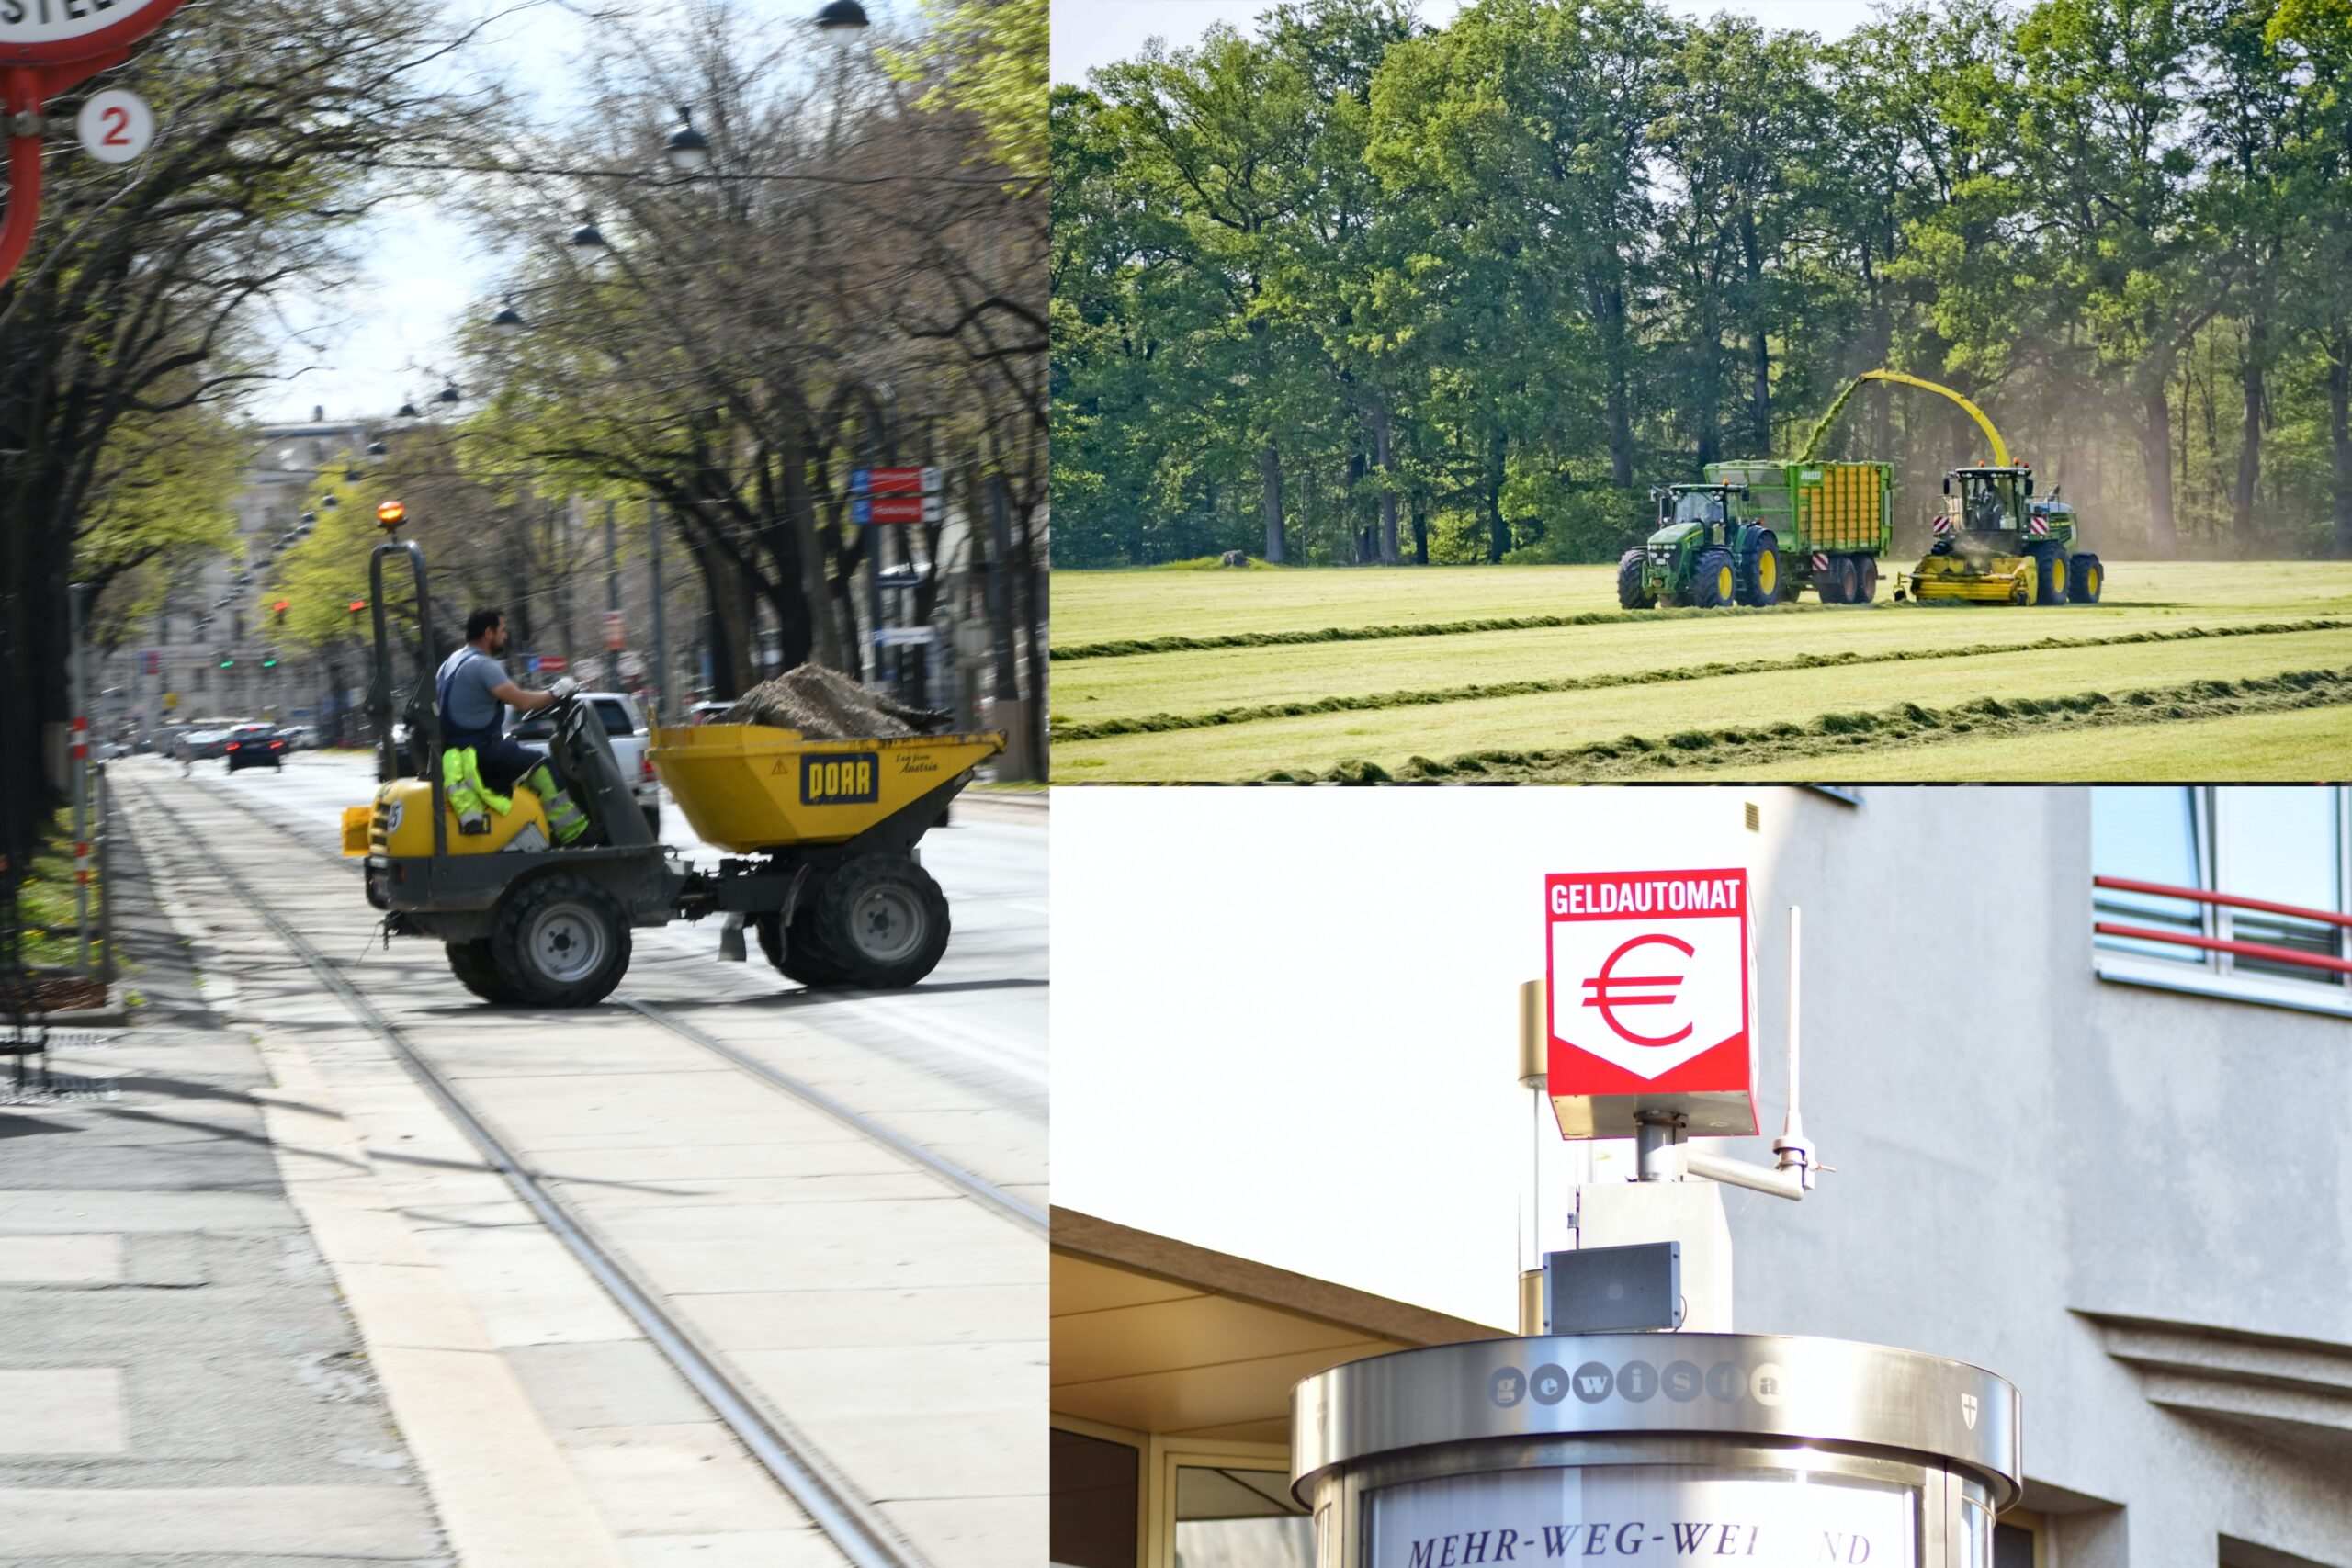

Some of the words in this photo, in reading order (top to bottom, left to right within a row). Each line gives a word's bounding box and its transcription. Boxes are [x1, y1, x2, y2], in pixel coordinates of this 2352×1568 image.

[100, 106, 131, 147] 2
[899, 762, 938, 774] Austria
[1551, 879, 1741, 915] GELDAUTOMAT
[1581, 933, 1696, 1048] €
[1491, 1361, 1785, 1405] gewista
